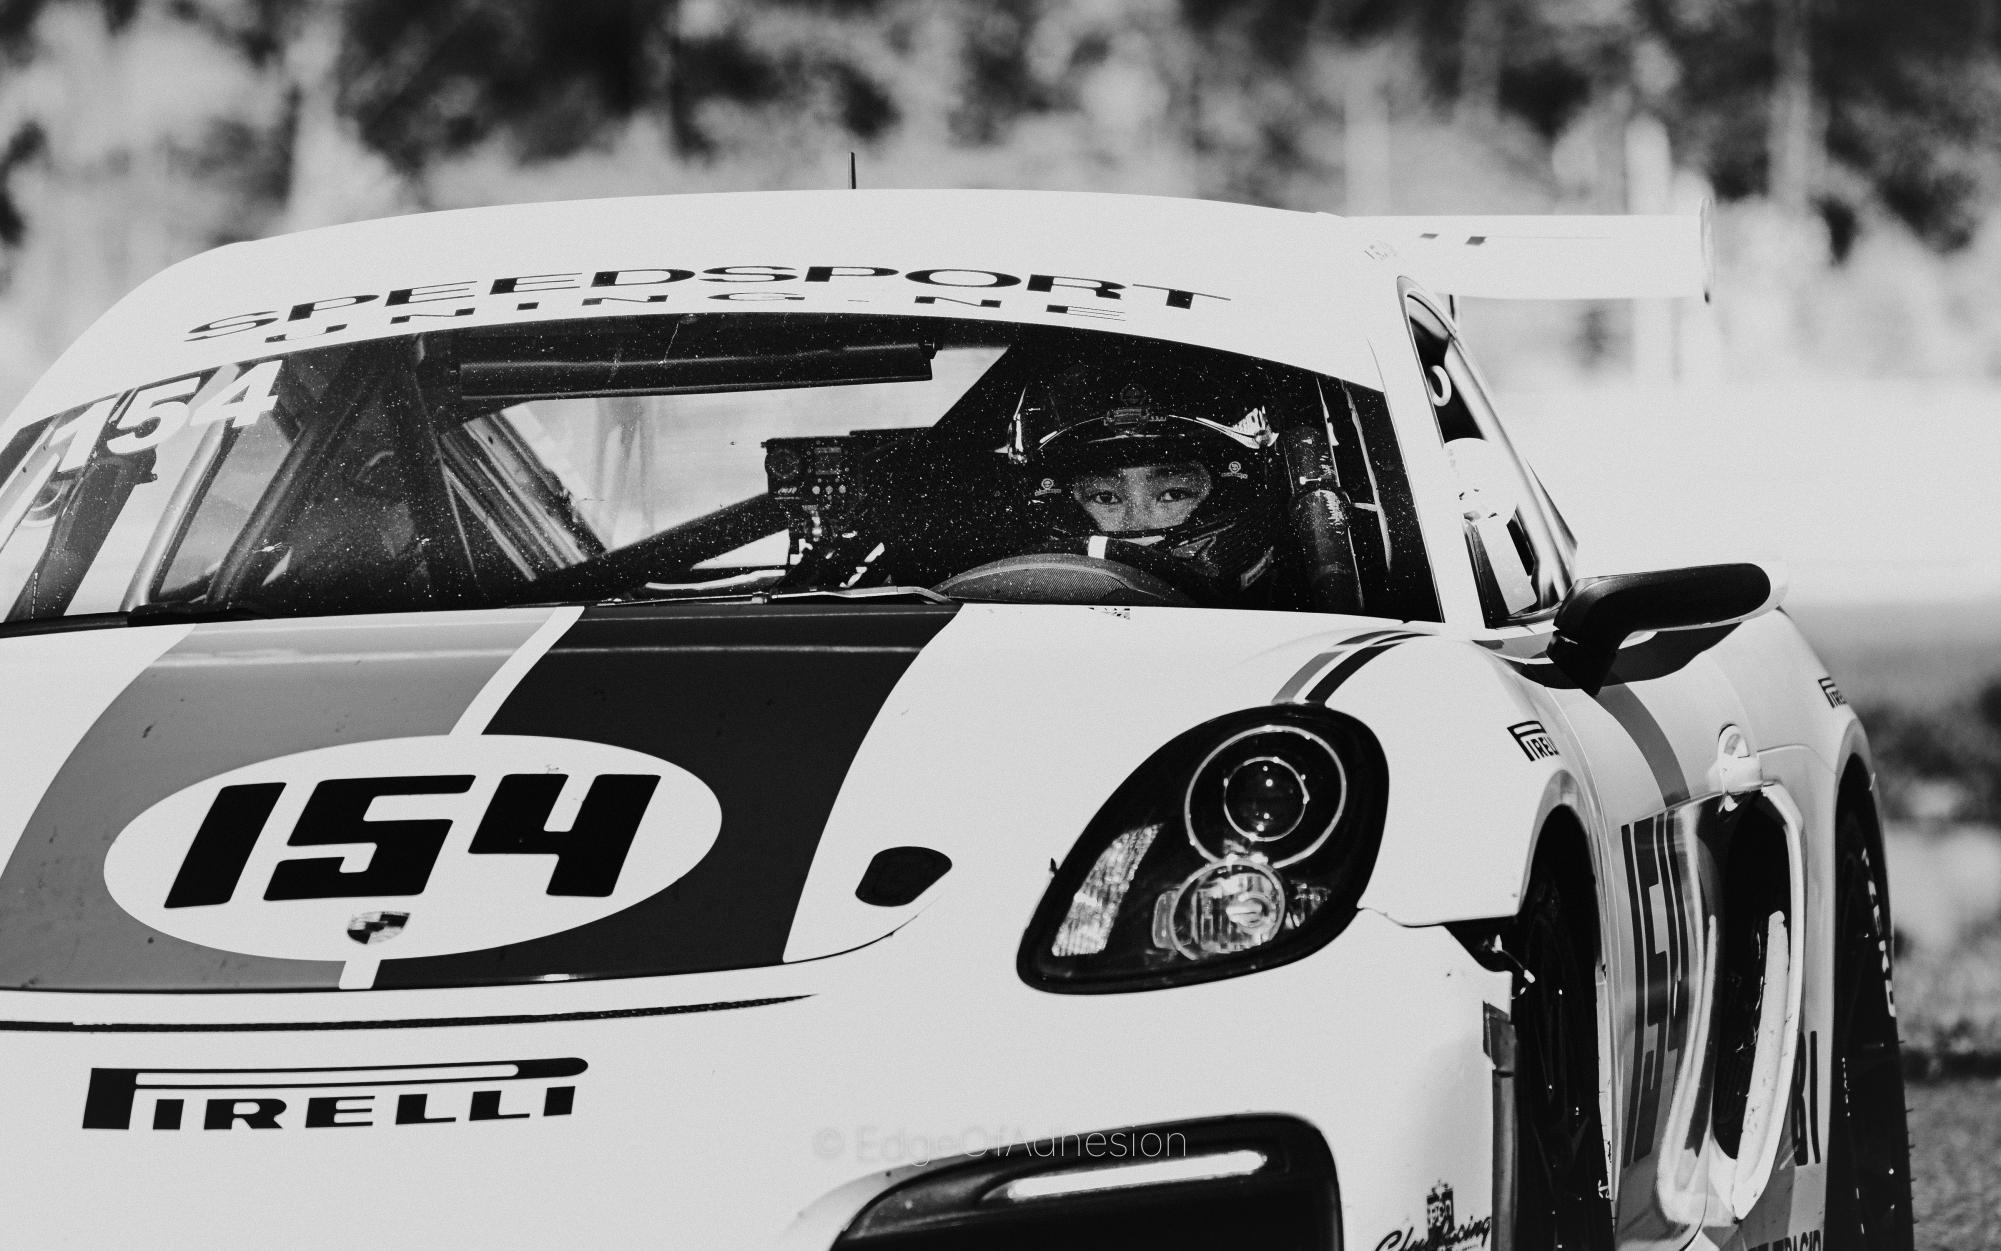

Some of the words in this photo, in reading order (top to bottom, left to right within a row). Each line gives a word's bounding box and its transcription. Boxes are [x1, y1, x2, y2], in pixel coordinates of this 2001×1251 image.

[184, 265, 1231, 342] SPEEDSPORT
[49, 360, 282, 473] 154
[164, 774, 661, 909] 154
[82, 1057, 589, 1131] PIRELLI
